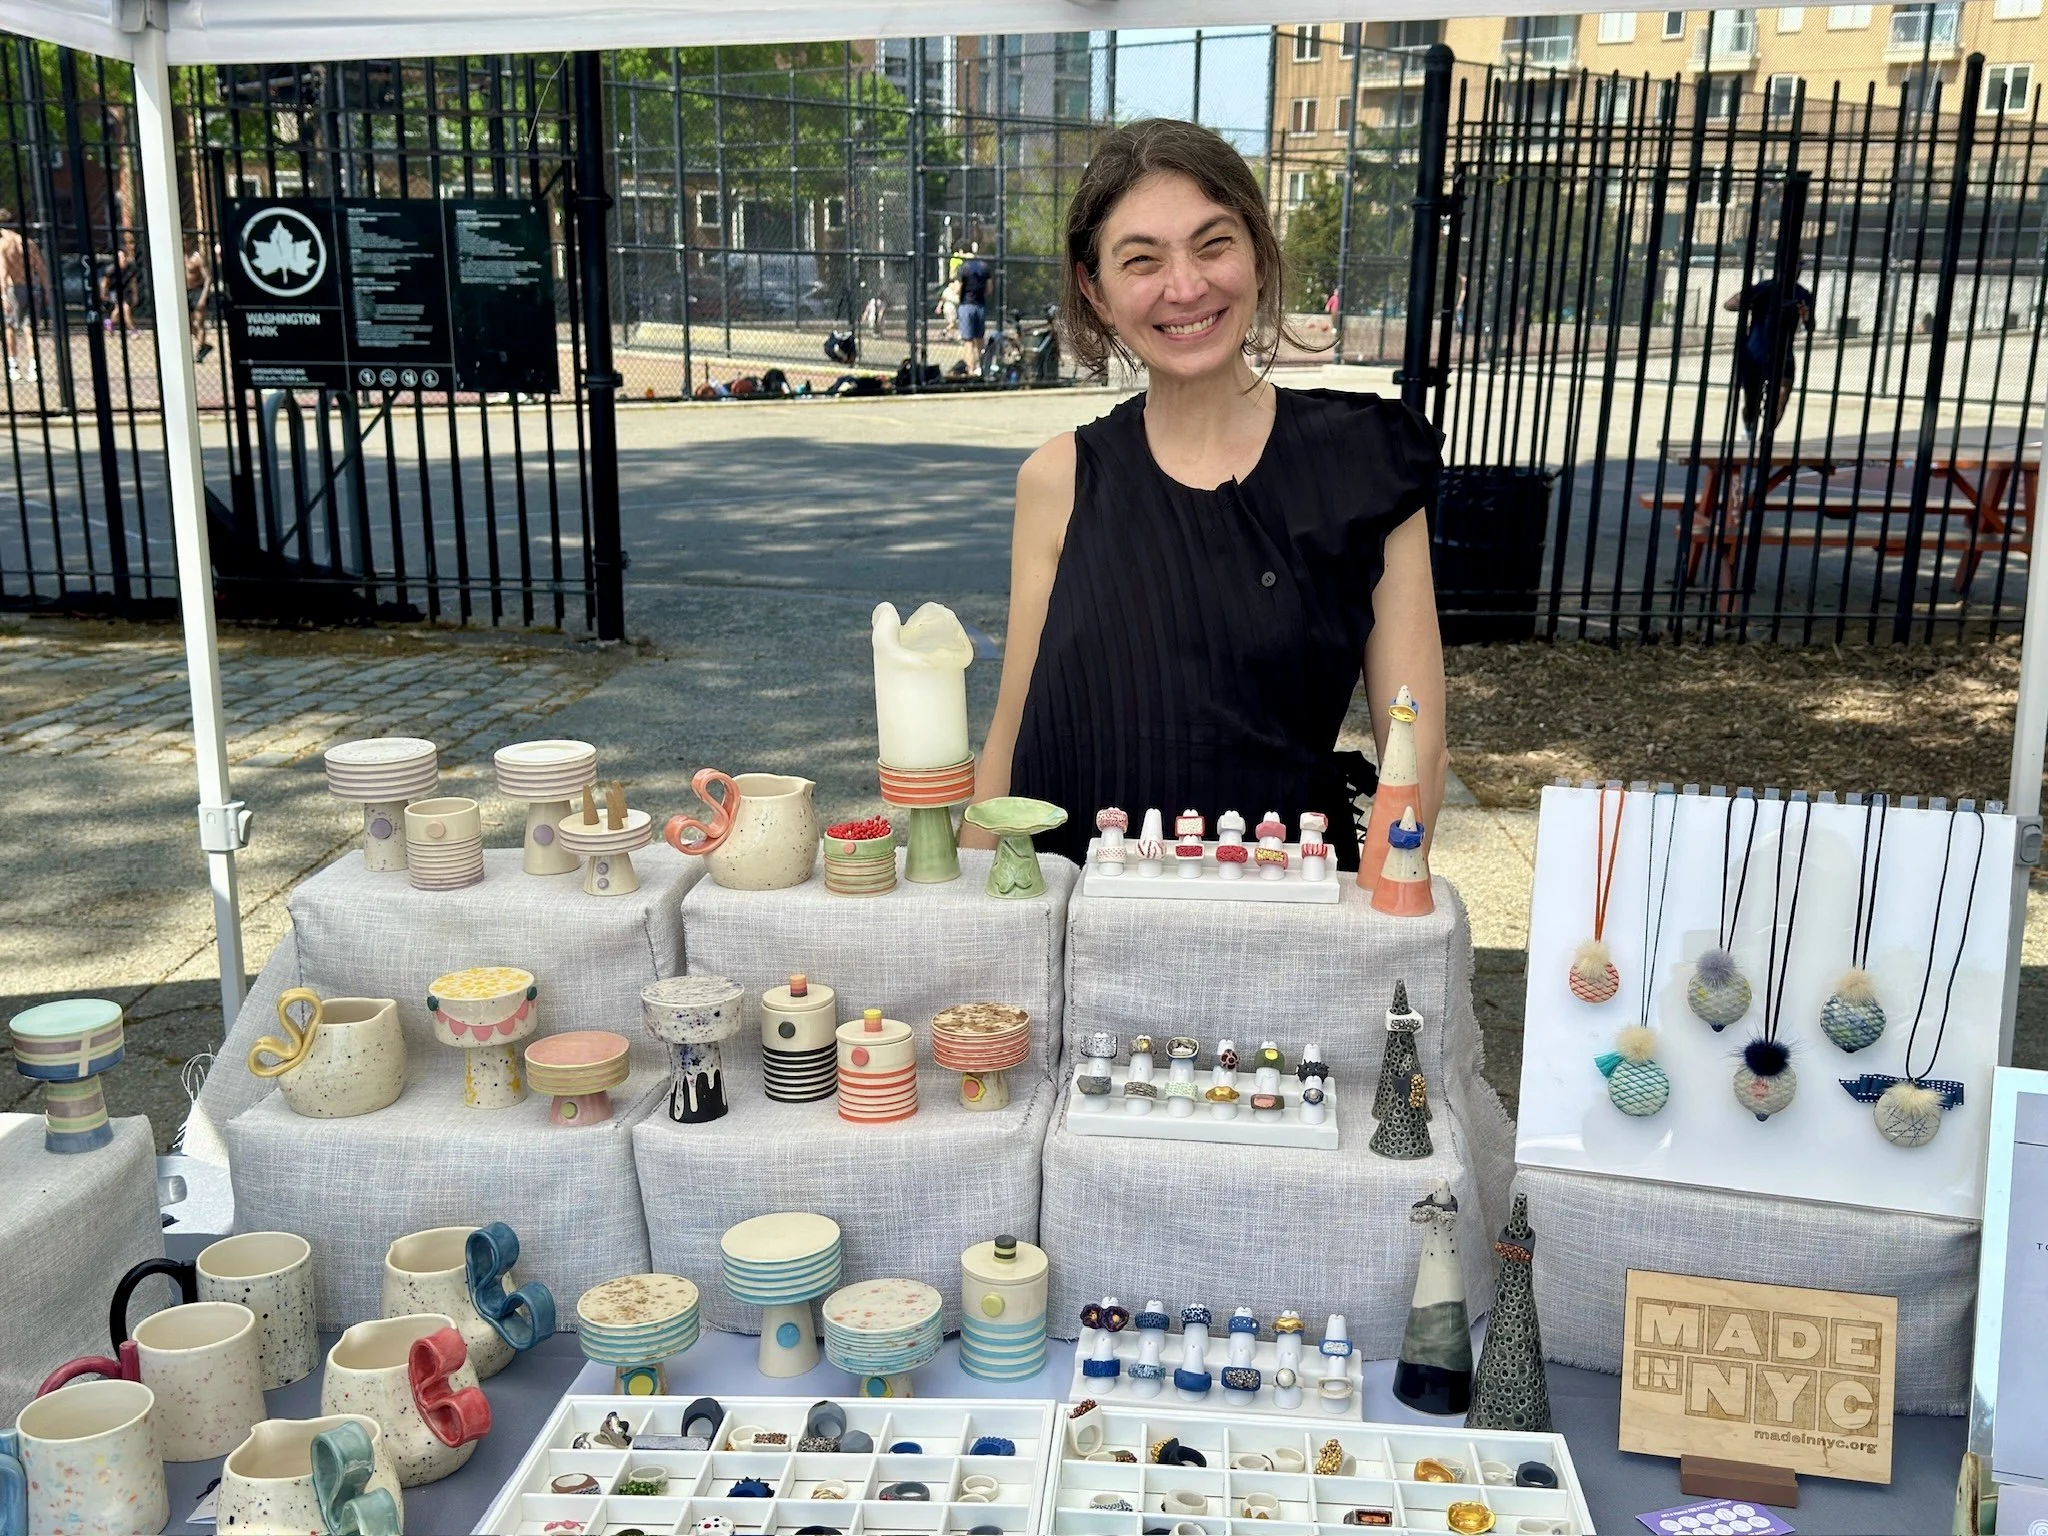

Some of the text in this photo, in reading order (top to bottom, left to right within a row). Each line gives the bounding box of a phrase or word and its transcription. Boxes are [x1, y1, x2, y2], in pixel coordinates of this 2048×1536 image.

[245, 312, 321, 325] WASHINGTON
[247, 325, 279, 337] PARK
[1640, 1302, 1877, 1368] MADE
[1639, 1356, 1874, 1430] IN NYC
[1754, 1429, 1878, 1455] madeinnyc.org
